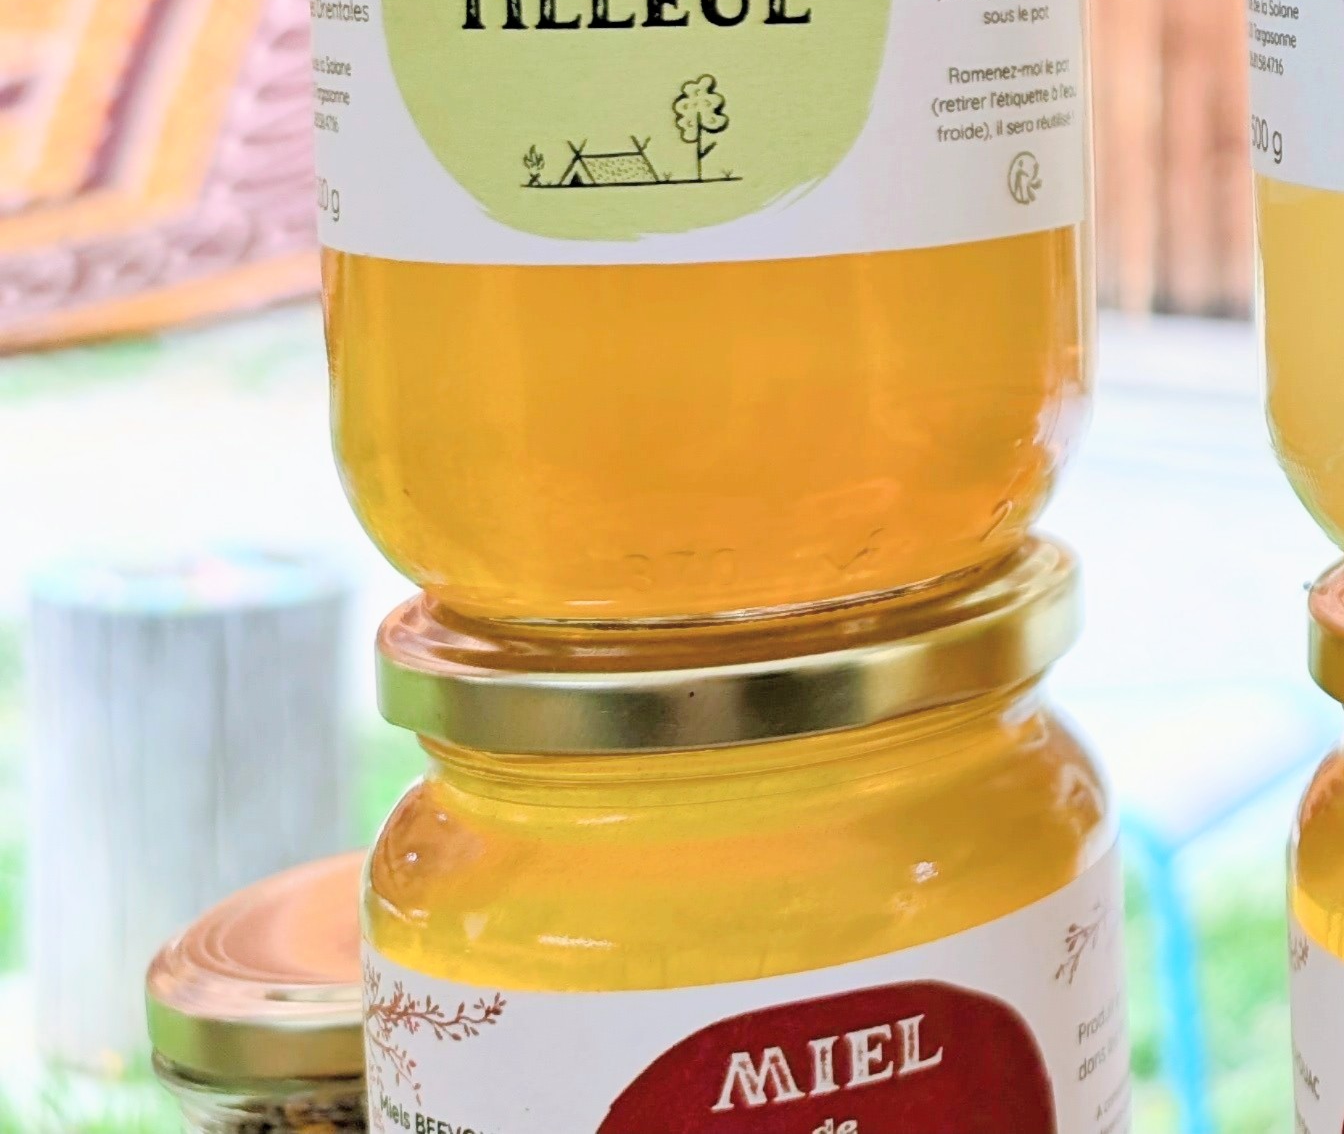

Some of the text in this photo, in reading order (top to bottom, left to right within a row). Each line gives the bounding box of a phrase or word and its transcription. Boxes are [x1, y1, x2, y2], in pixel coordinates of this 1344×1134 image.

[983, 9, 1015, 25] sous
[1018, 5, 1028, 22] le
[1272, 130, 1283, 164] g
[710, 1014, 944, 1113] MIEL
